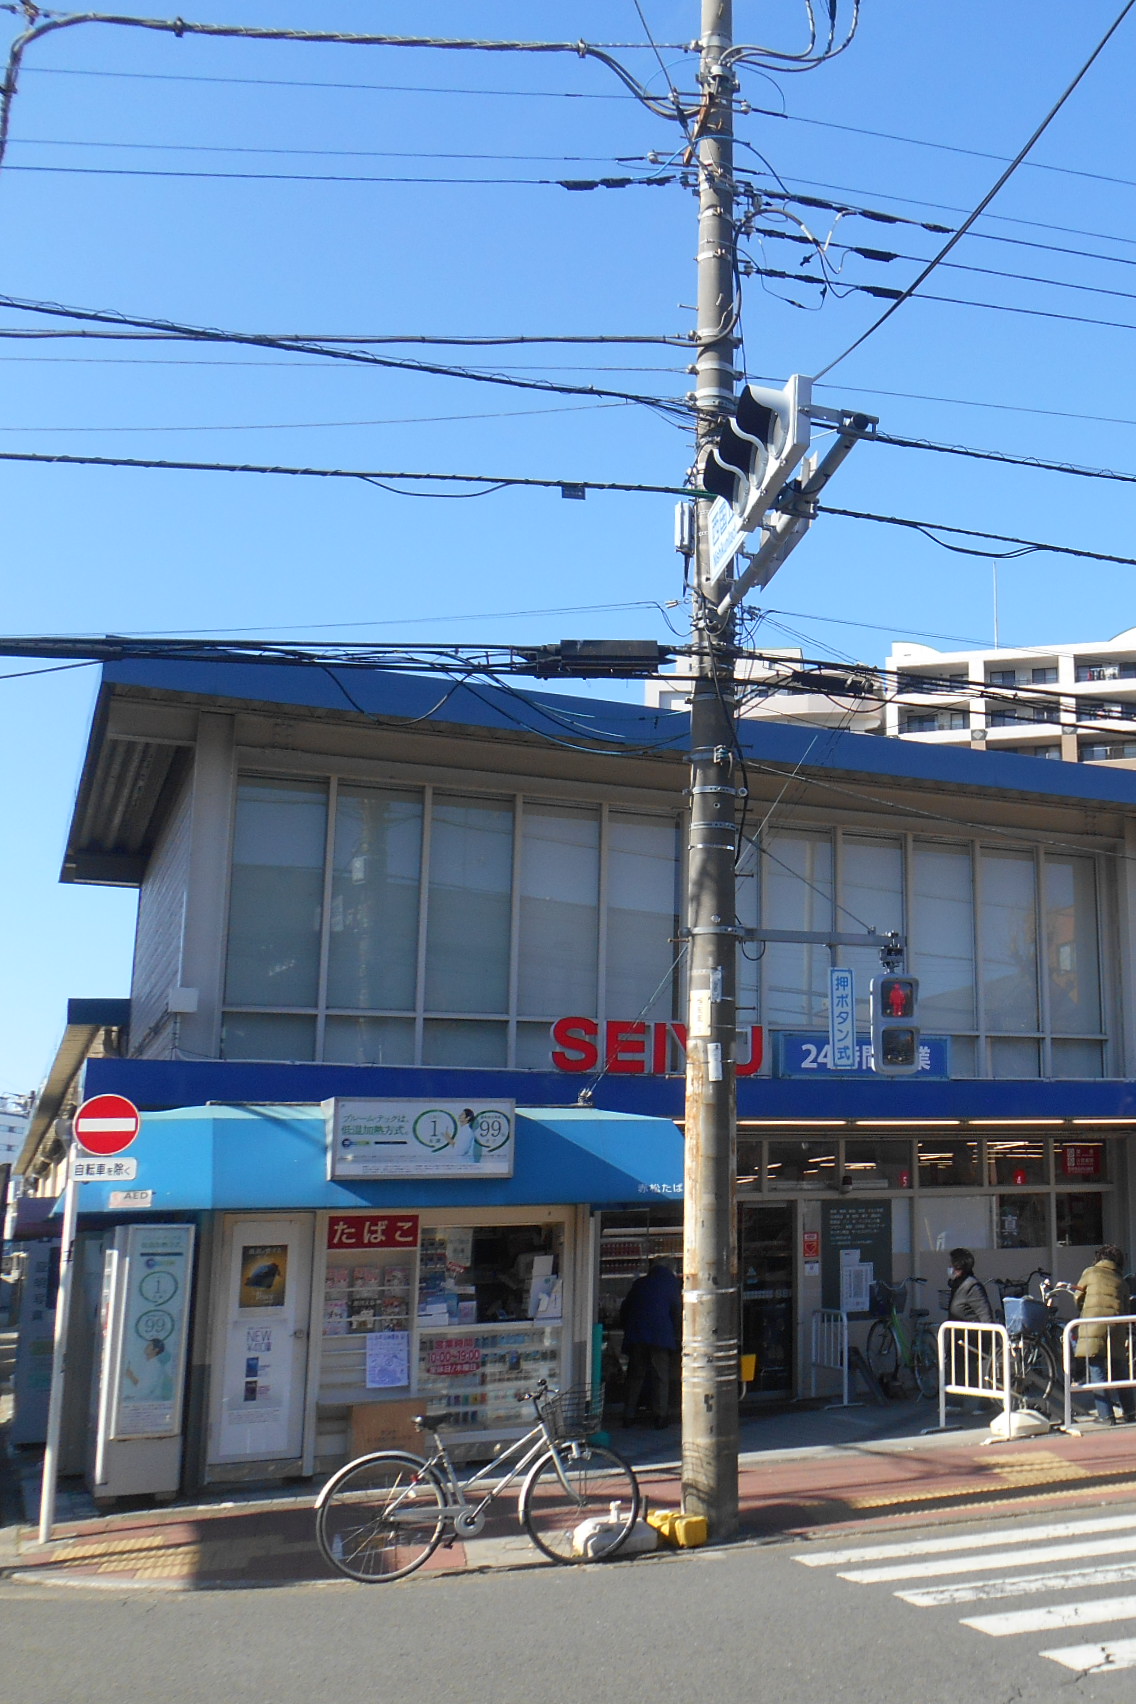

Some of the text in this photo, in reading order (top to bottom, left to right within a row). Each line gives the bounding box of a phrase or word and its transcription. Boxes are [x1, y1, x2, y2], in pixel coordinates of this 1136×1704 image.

[835, 975, 851, 1061] 押ボタン式
[551, 1016, 764, 1076] SEIU
[479, 1120, 502, 1138] 99
[74, 1162, 131, 1176] 自転車を除く
[123, 1191, 149, 1200] AED
[333, 1220, 413, 1244] たばこ
